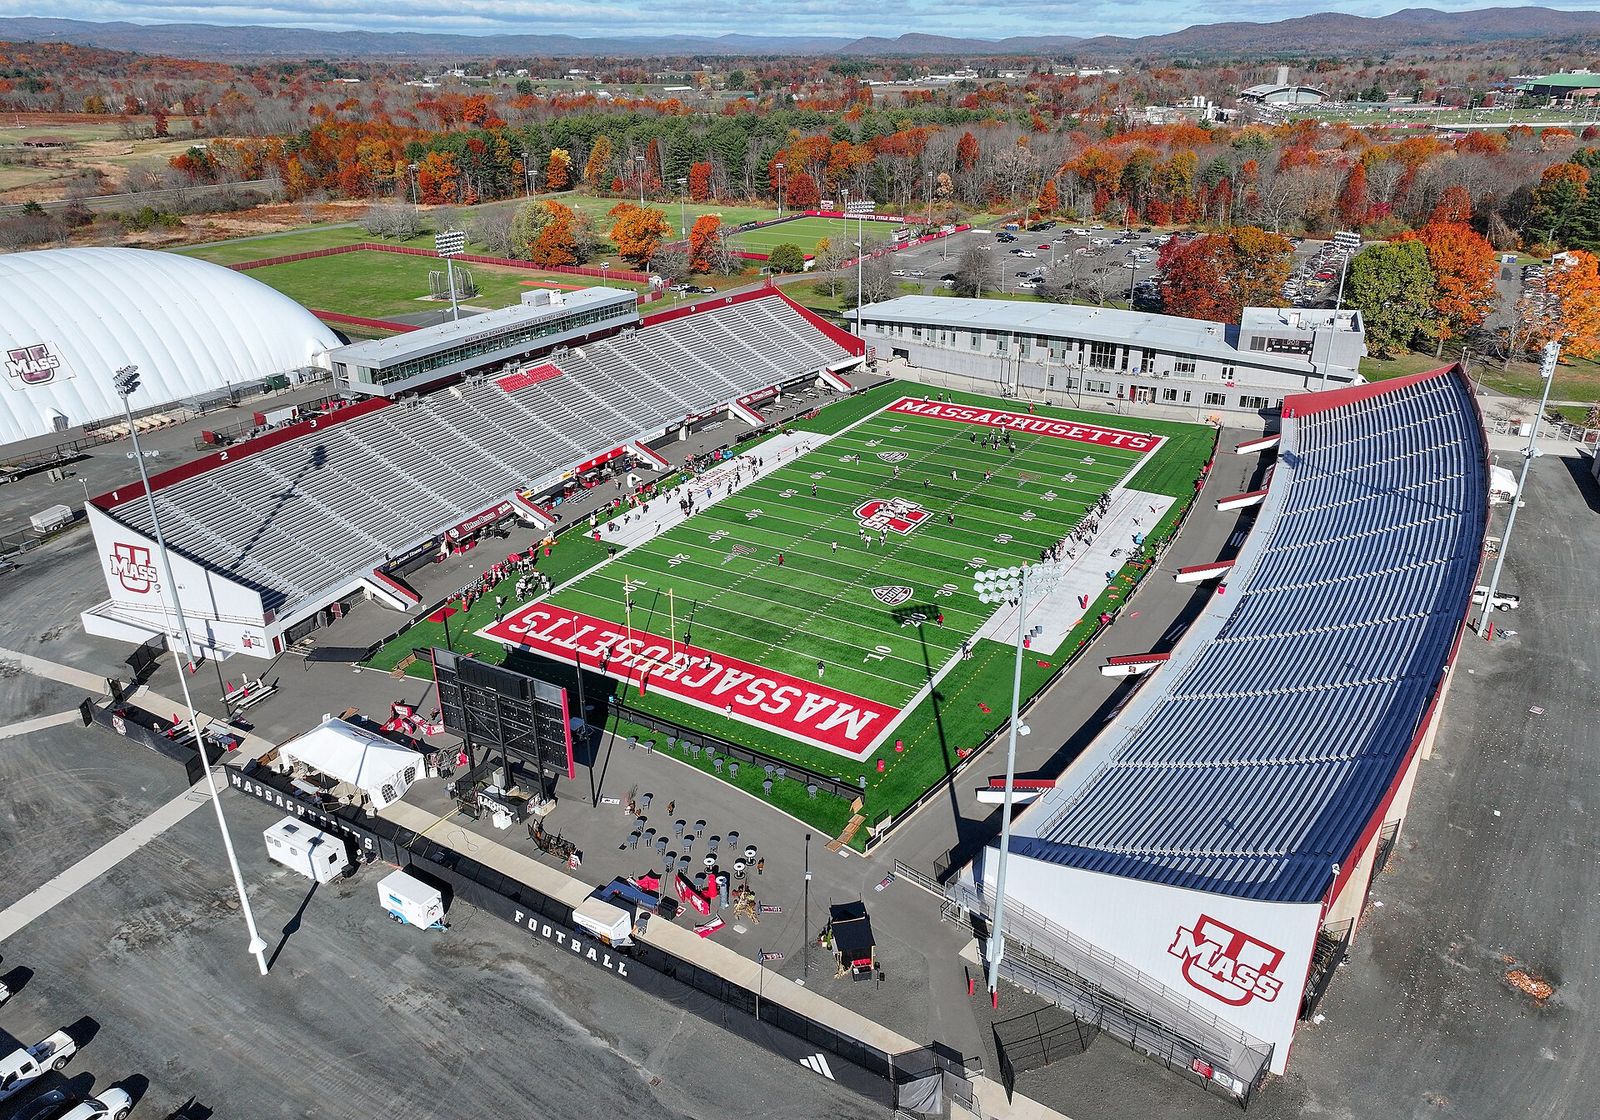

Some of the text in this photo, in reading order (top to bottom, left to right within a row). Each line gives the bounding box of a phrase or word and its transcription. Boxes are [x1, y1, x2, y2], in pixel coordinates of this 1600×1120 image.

[310, 420, 318, 428] 3
[896, 401, 1154, 449] MASSACHUSETTS
[220, 452, 228, 460] 2
[112, 492, 118, 501] 1
[904, 612, 927, 628] 20
[868, 645, 892, 662] 10
[508, 610, 882, 741] MASSACHUSETTS
[231, 773, 373, 850] MASSACHUSETTS
[514, 909, 628, 977] FOOTBALL
